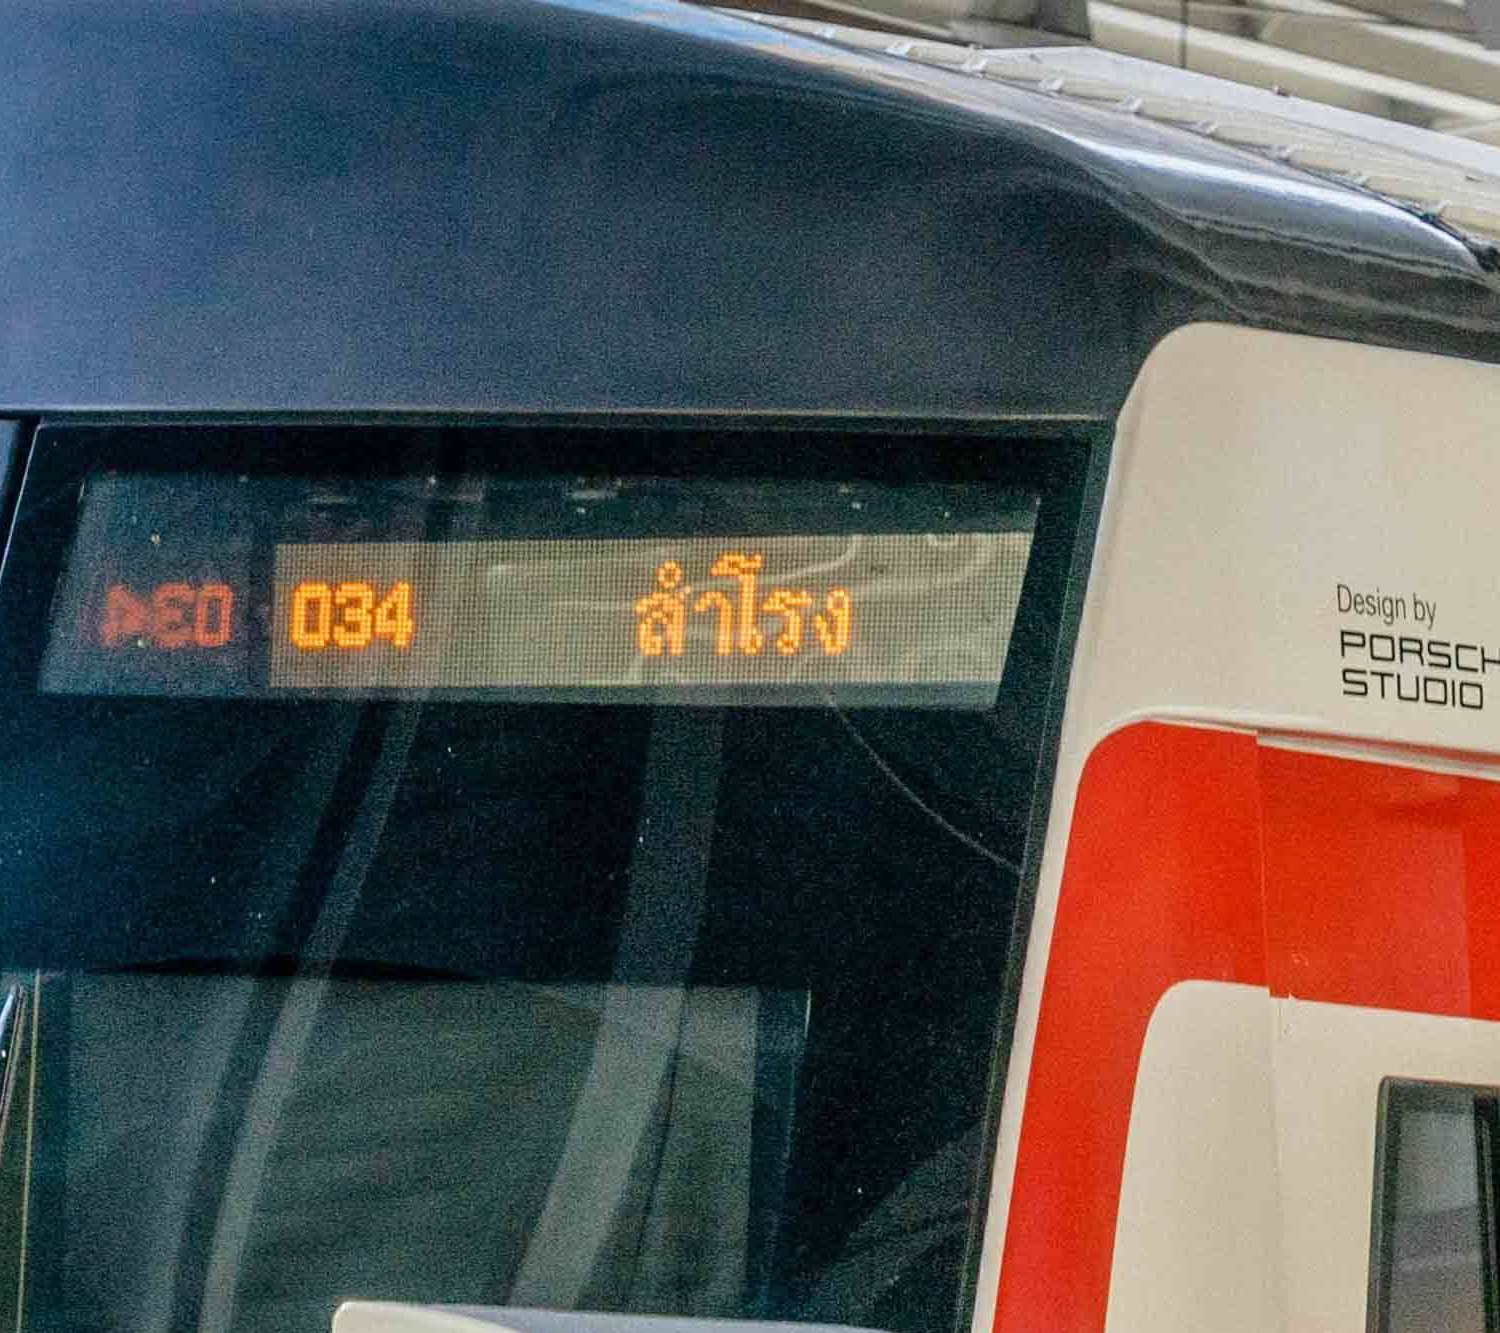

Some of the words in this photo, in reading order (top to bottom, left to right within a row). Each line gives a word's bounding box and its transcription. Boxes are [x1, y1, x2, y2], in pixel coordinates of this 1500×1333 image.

[291, 581, 414, 649] 034
[633, 552, 852, 658] สำโรง
[1336, 583, 1407, 626] Design
[1413, 592, 1437, 631] by
[1341, 668, 1484, 710] STUDIO
